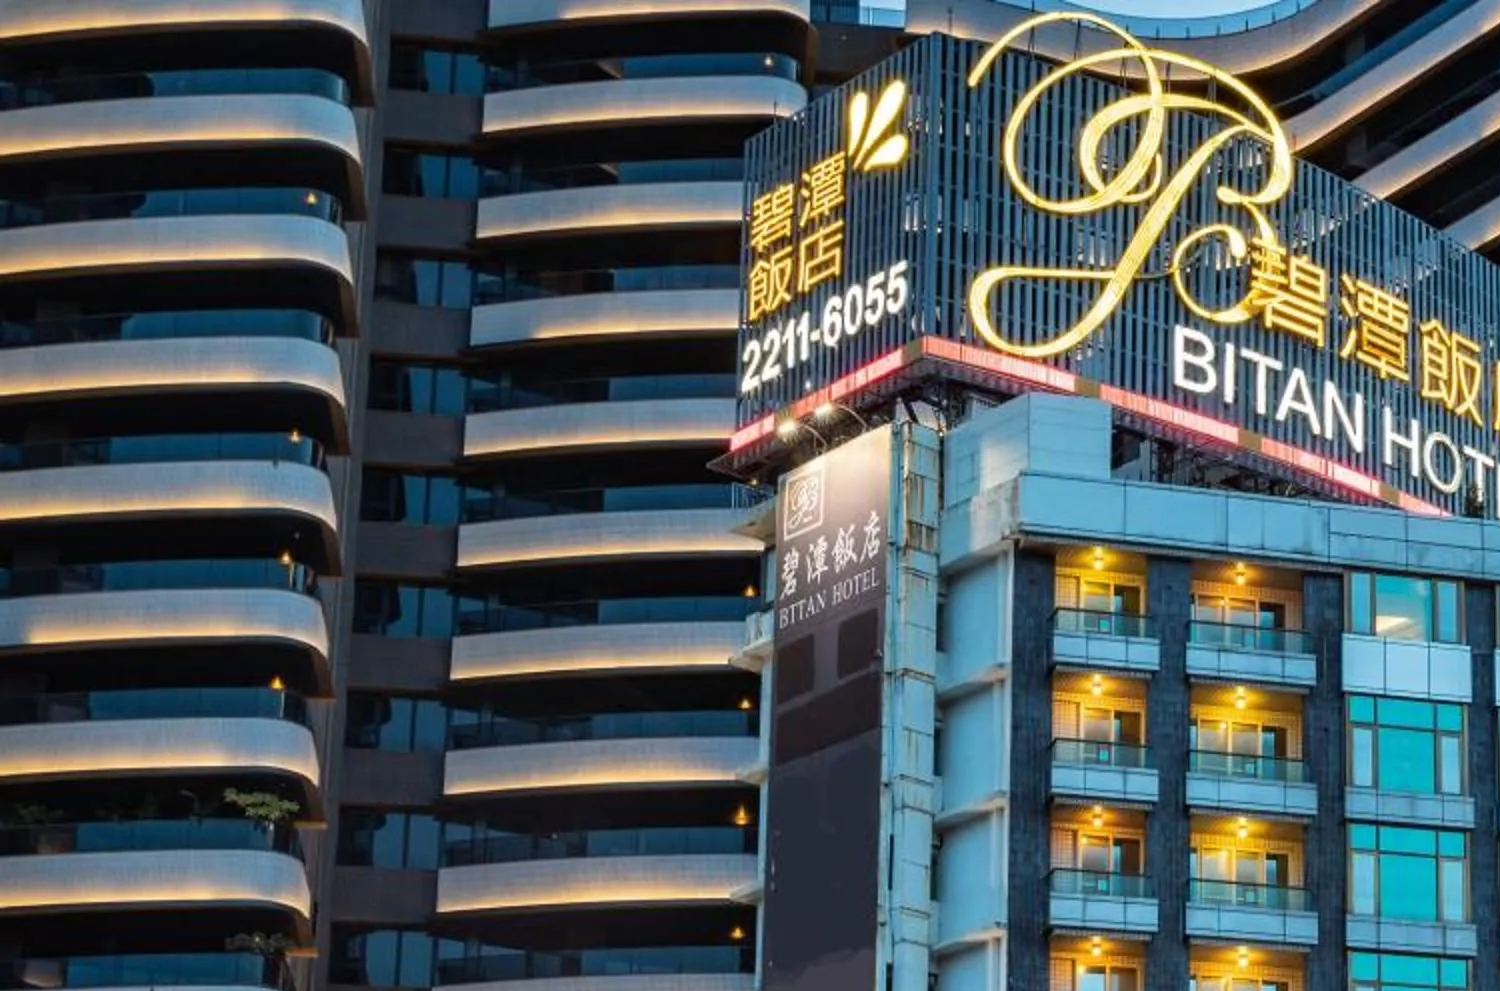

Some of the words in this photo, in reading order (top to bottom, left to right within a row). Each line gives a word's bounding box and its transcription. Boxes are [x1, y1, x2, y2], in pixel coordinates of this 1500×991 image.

[750, 150, 846, 252] 碧潭
[749, 219, 845, 323] 飯店
[741, 259, 909, 395] 2211-6055
[1173, 323, 1365, 455] BITAN
[779, 509, 881, 600] 碧潭飯店
[779, 589, 828, 630] BITAN
[832, 567, 880, 605] HOTEL
